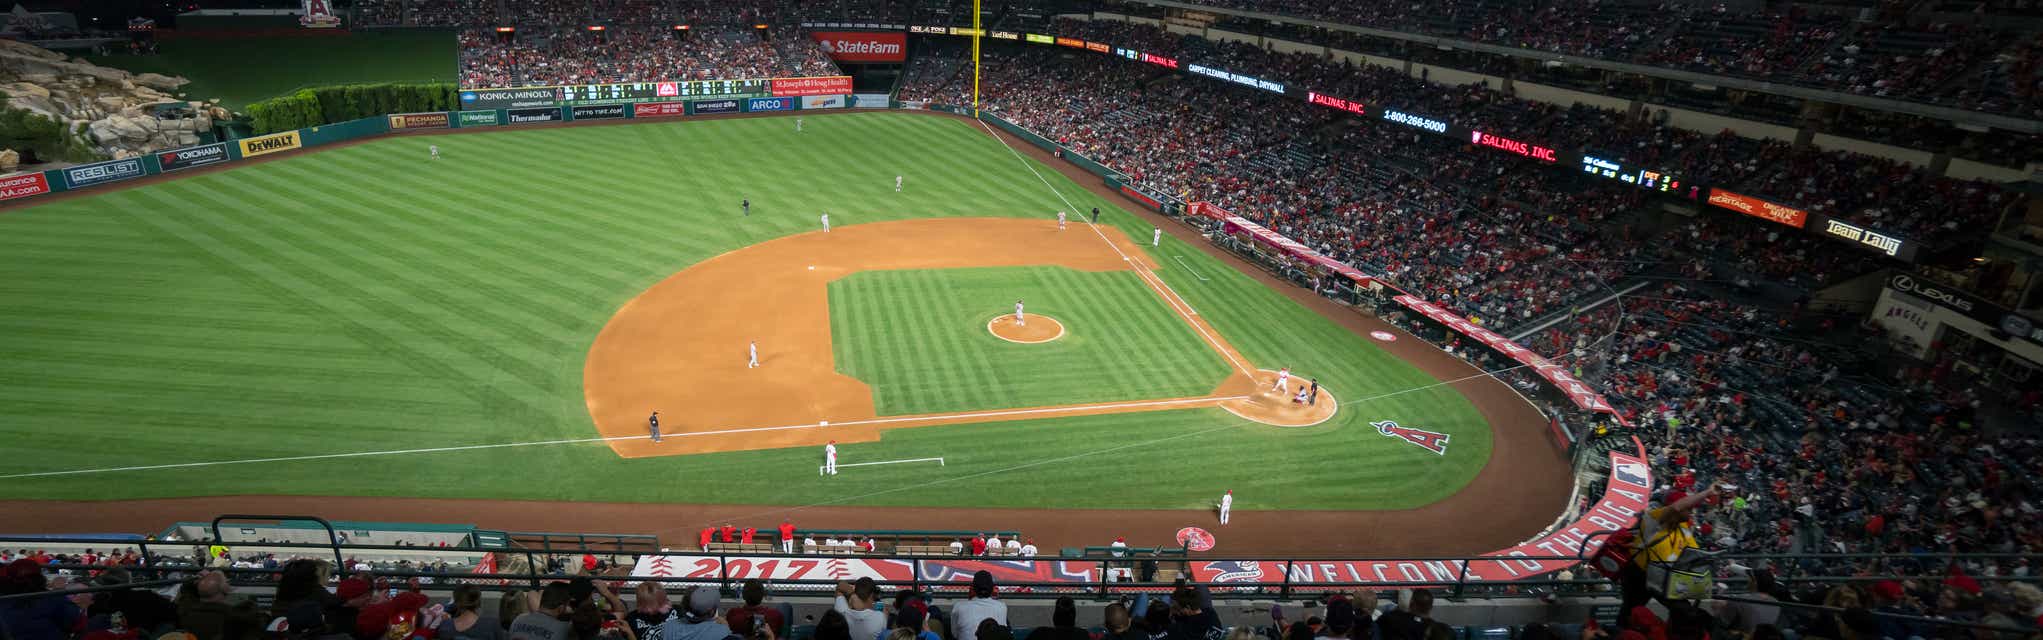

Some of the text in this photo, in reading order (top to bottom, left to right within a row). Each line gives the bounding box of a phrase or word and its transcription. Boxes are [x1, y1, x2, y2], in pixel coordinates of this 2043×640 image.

[1188, 63, 1206, 74] CARPET
[1258, 80, 1285, 94] DRYWALL
[479, 91, 514, 101] KONICA
[514, 90, 553, 99] MINOLTA
[751, 100, 781, 110] ARCO
[1314, 94, 1365, 114] SALINAS, INC.
[177, 146, 223, 160] YOKOHAMA
[1481, 133, 1556, 161] SALINAS, INC.
[1708, 195, 1753, 212] HERITAGE
[1762, 202, 1800, 217] ORGANIC
[1826, 219, 1864, 241] Team
[1914, 283, 1974, 312] LEXUS
[1887, 306, 1929, 331] ANGELS
[1277, 487, 1645, 582] WELCOME TO THE BIG A
[686, 558, 820, 580] 2017
